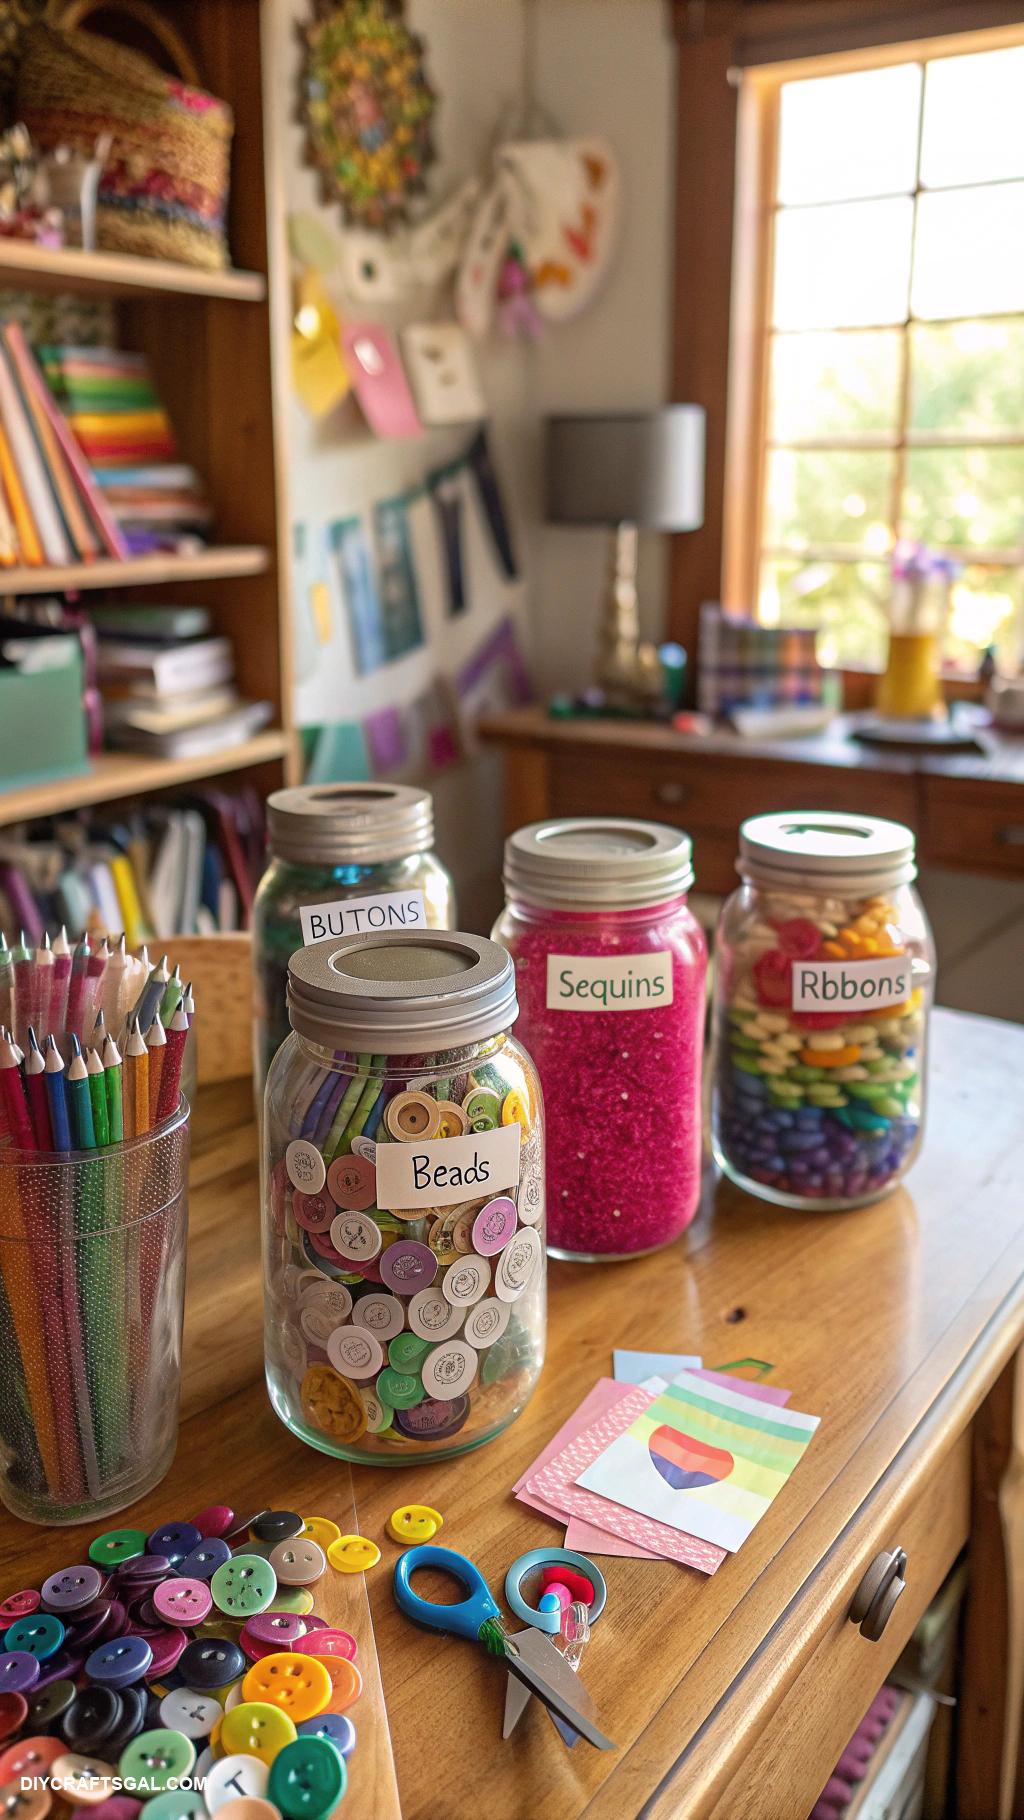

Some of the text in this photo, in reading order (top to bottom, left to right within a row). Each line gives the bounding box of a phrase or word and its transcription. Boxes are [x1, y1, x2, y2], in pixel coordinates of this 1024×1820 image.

[310, 900, 419, 939] BUTONS
[559, 970, 664, 1006] Sequins
[801, 970, 905, 1000] Rbbons
[412, 1151, 490, 1189] Beads
